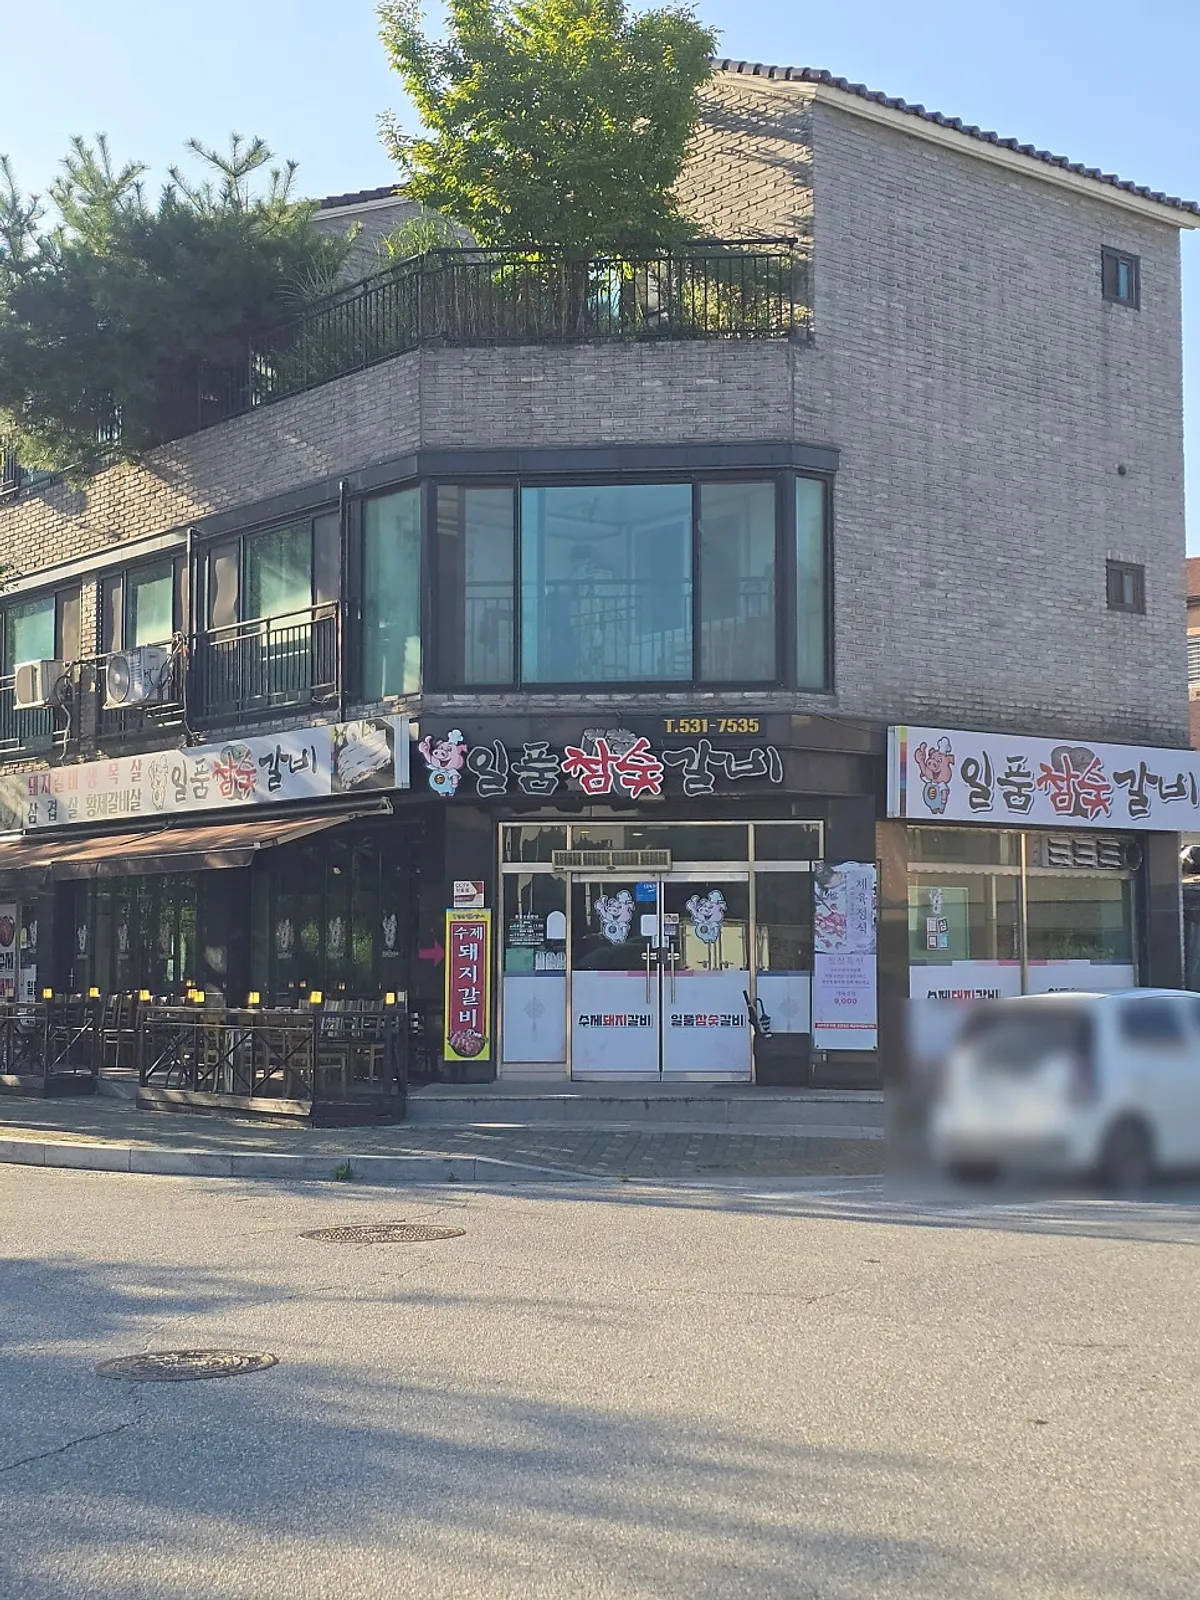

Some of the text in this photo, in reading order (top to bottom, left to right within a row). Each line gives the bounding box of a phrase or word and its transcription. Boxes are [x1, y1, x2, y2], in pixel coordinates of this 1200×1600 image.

[664, 718, 760, 734] T.531-7535
[28, 767, 79, 796] 돼지갈비
[86, 788, 141, 818] 황제갈비살
[855, 877, 869, 935] 제육정식
[454, 926, 482, 941] 수제
[458, 943, 480, 1028] 돼지갈비
[578, 1014, 652, 1027] 수제돼지갈비
[671, 1014, 744, 1027] 일품참숯갈비
